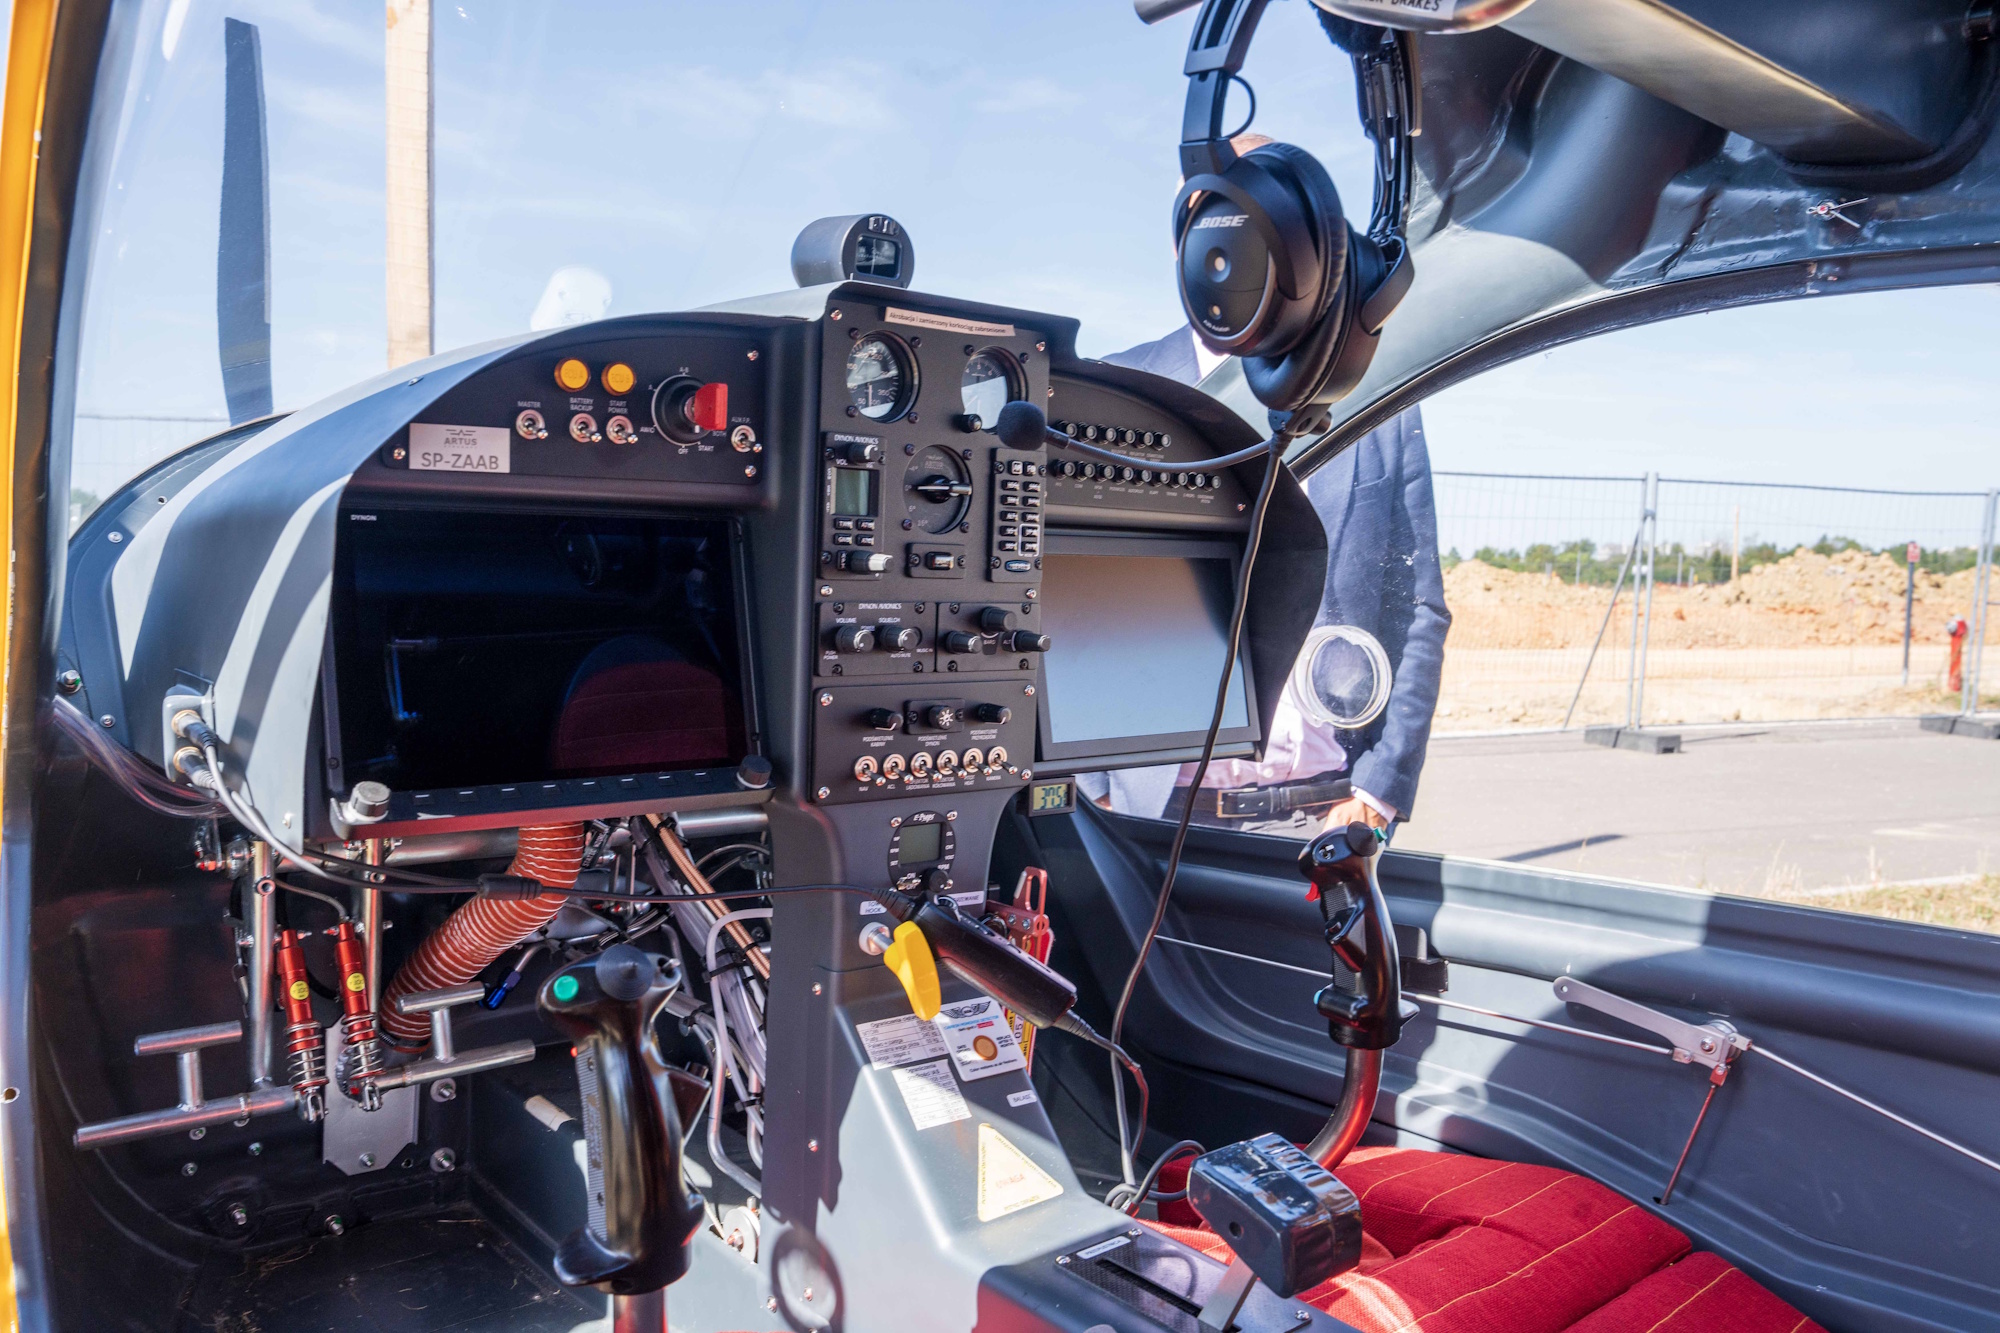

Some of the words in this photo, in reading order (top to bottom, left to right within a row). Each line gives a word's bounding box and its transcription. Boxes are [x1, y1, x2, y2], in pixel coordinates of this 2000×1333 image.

[1193, 215, 1249, 229] BOSE
[569, 397, 594, 405] BATTERY
[834, 434, 853, 442] DYNON
[854, 436, 879, 444] AVIONICS
[421, 452, 499, 470] SP-ZAAB
